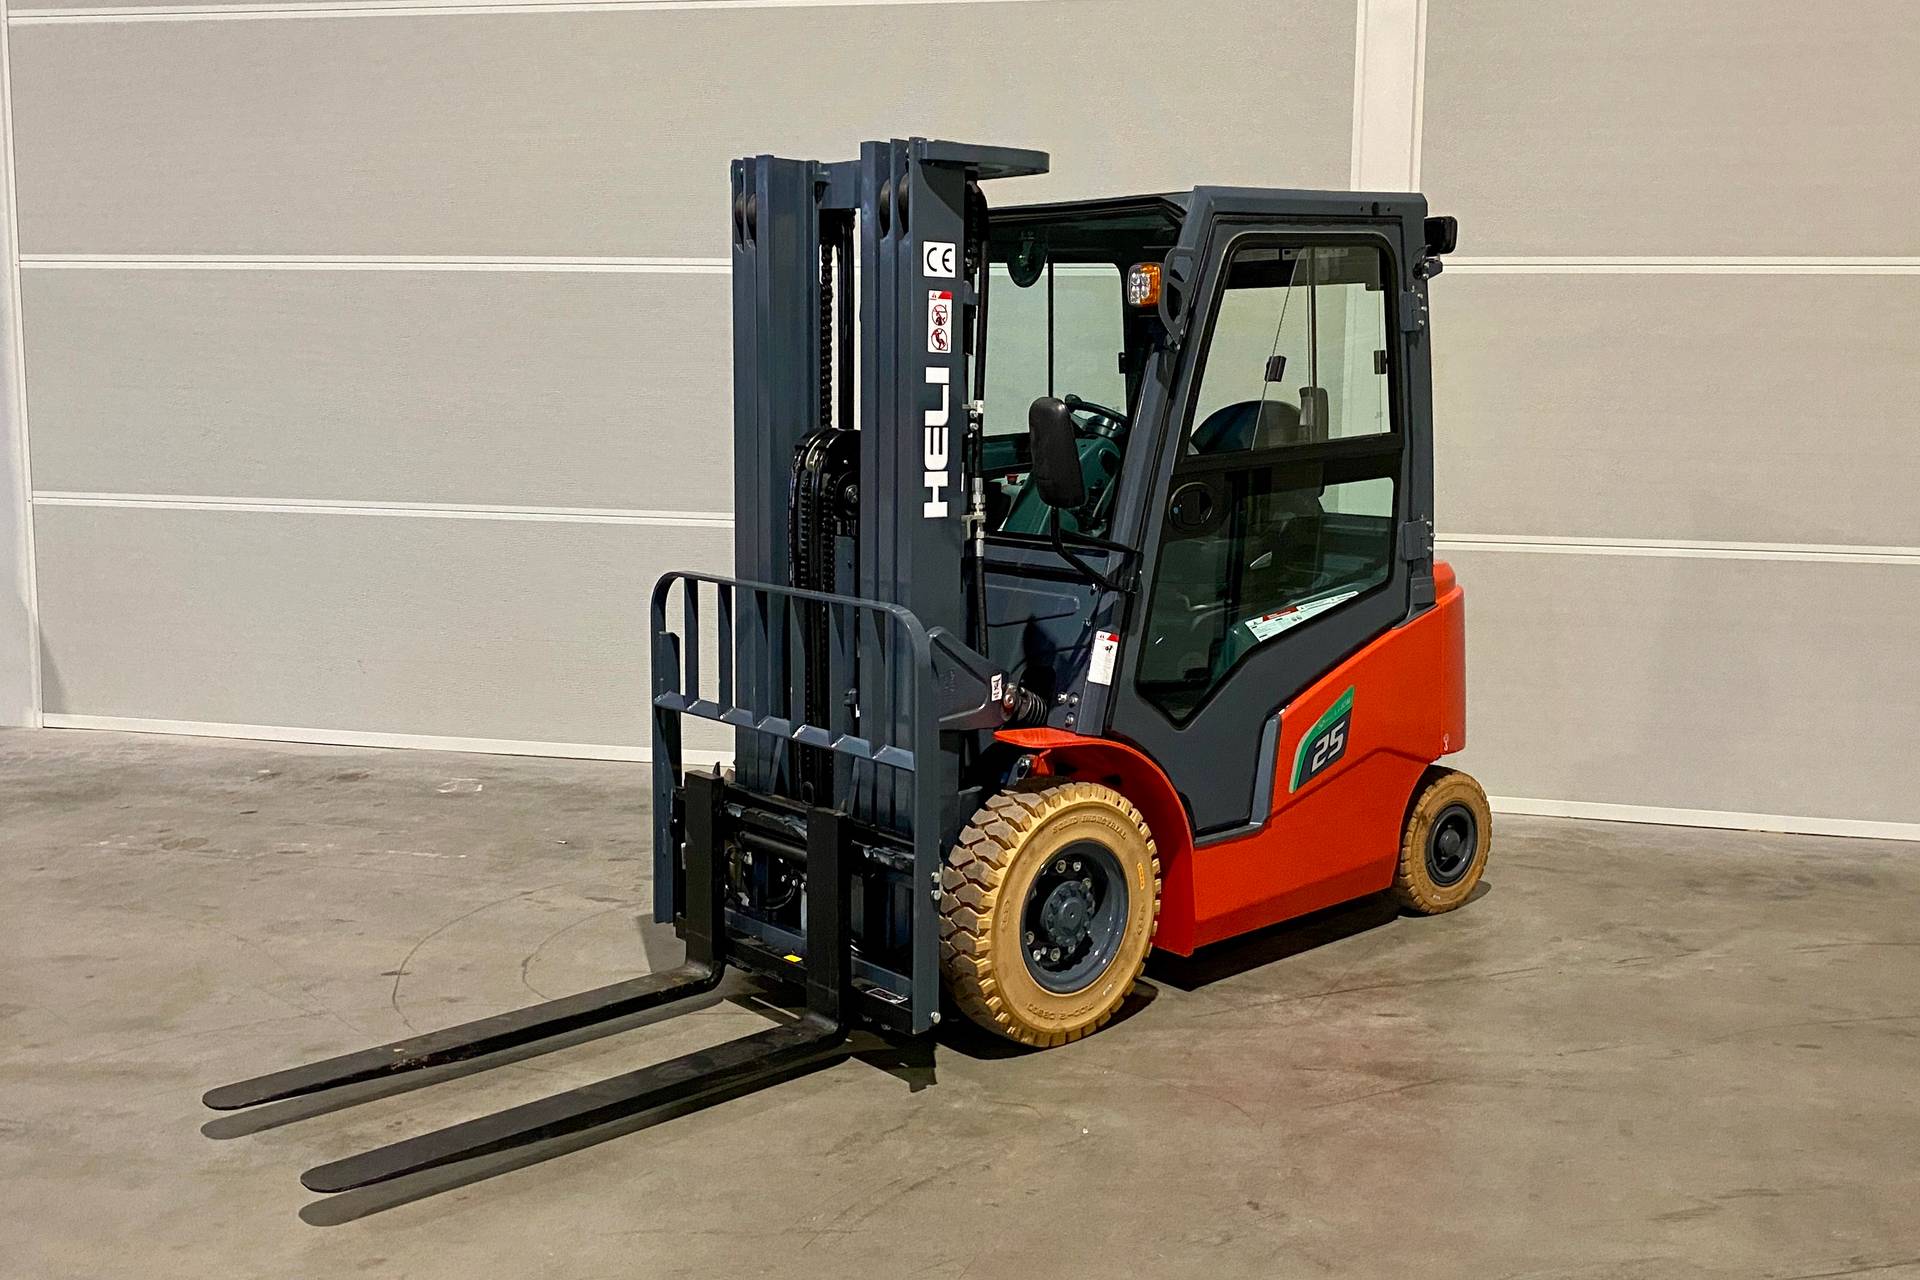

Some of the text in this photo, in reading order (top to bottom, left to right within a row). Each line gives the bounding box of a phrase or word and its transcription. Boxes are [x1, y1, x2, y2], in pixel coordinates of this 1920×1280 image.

[926, 247, 953, 273] CE
[923, 366, 950, 519] HELI
[1310, 720, 1346, 774] 25
